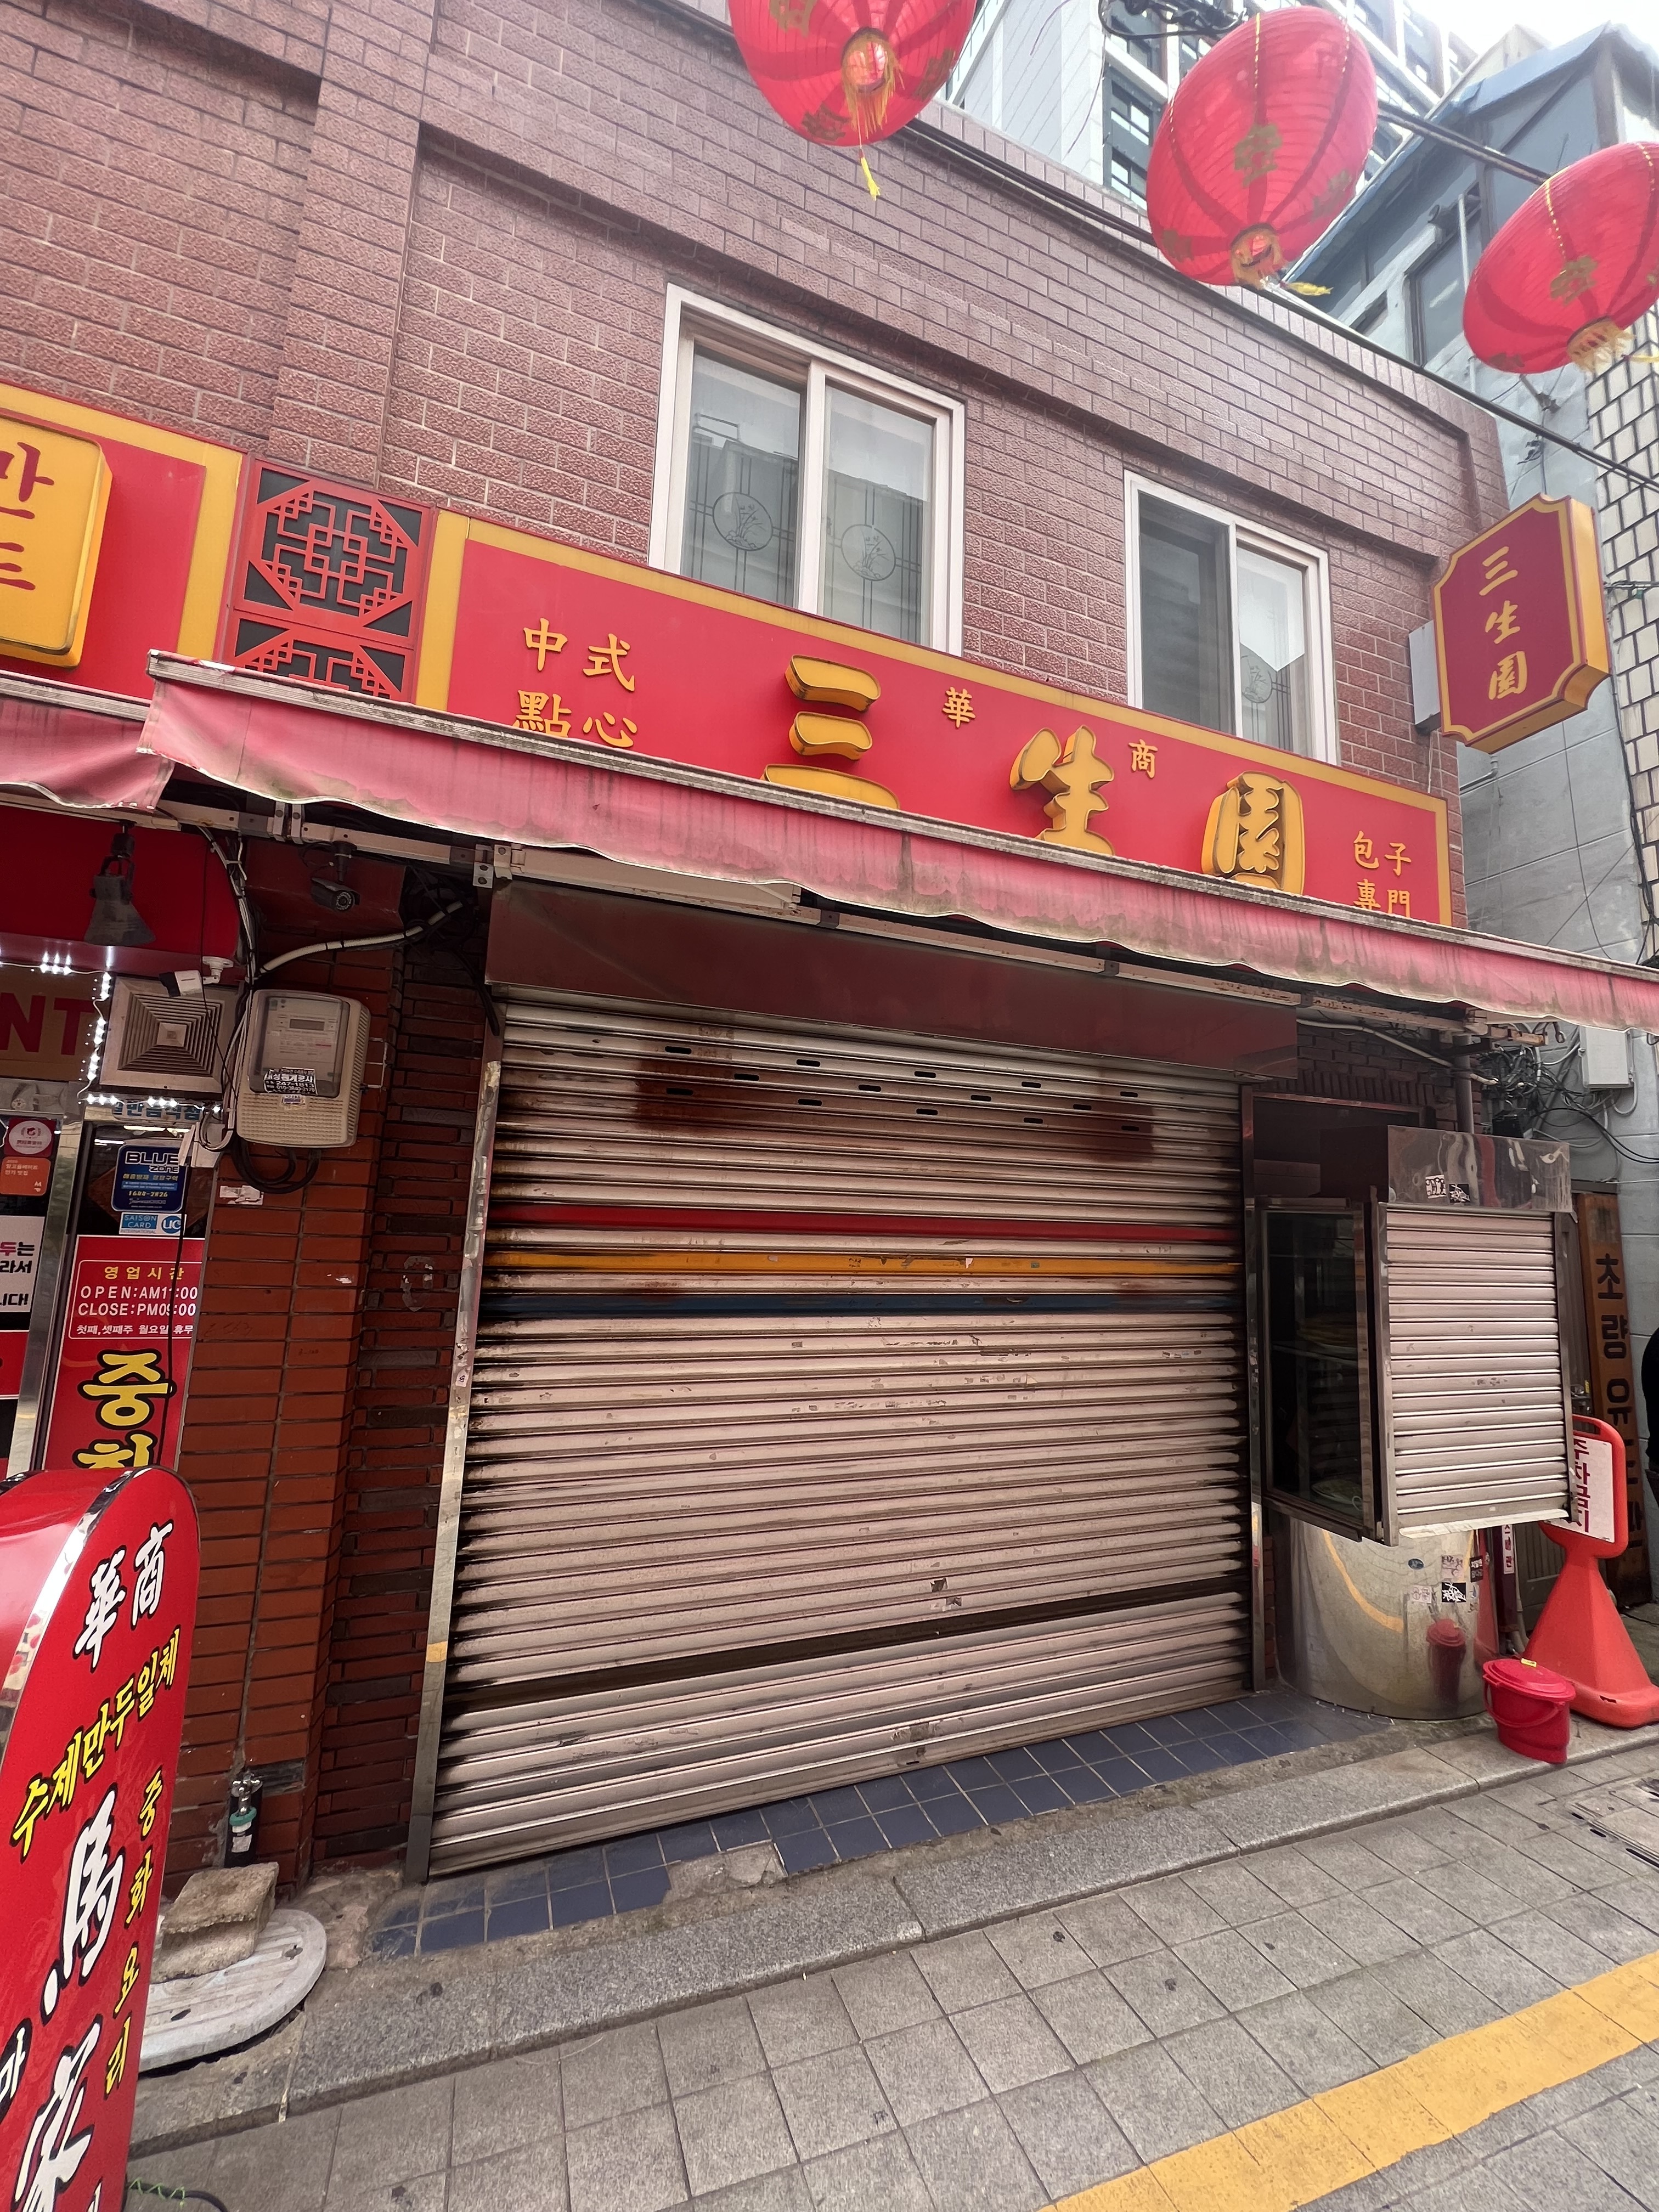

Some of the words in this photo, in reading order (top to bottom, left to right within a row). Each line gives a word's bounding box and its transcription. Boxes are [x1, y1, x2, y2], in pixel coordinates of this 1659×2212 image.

[523, 618, 635, 692] 中式
[1479, 546, 1528, 700] 三生園
[512, 690, 637, 747] 點心
[760, 654, 1305, 894] 三生園
[1353, 831, 1411, 877] 包子
[1353, 878, 1410, 917] 專門
[125, 1151, 179, 1165] BLUE
[12, 1628, 180, 1858] 수제만두일체
[105, 1768, 163, 2096] 중화요리
